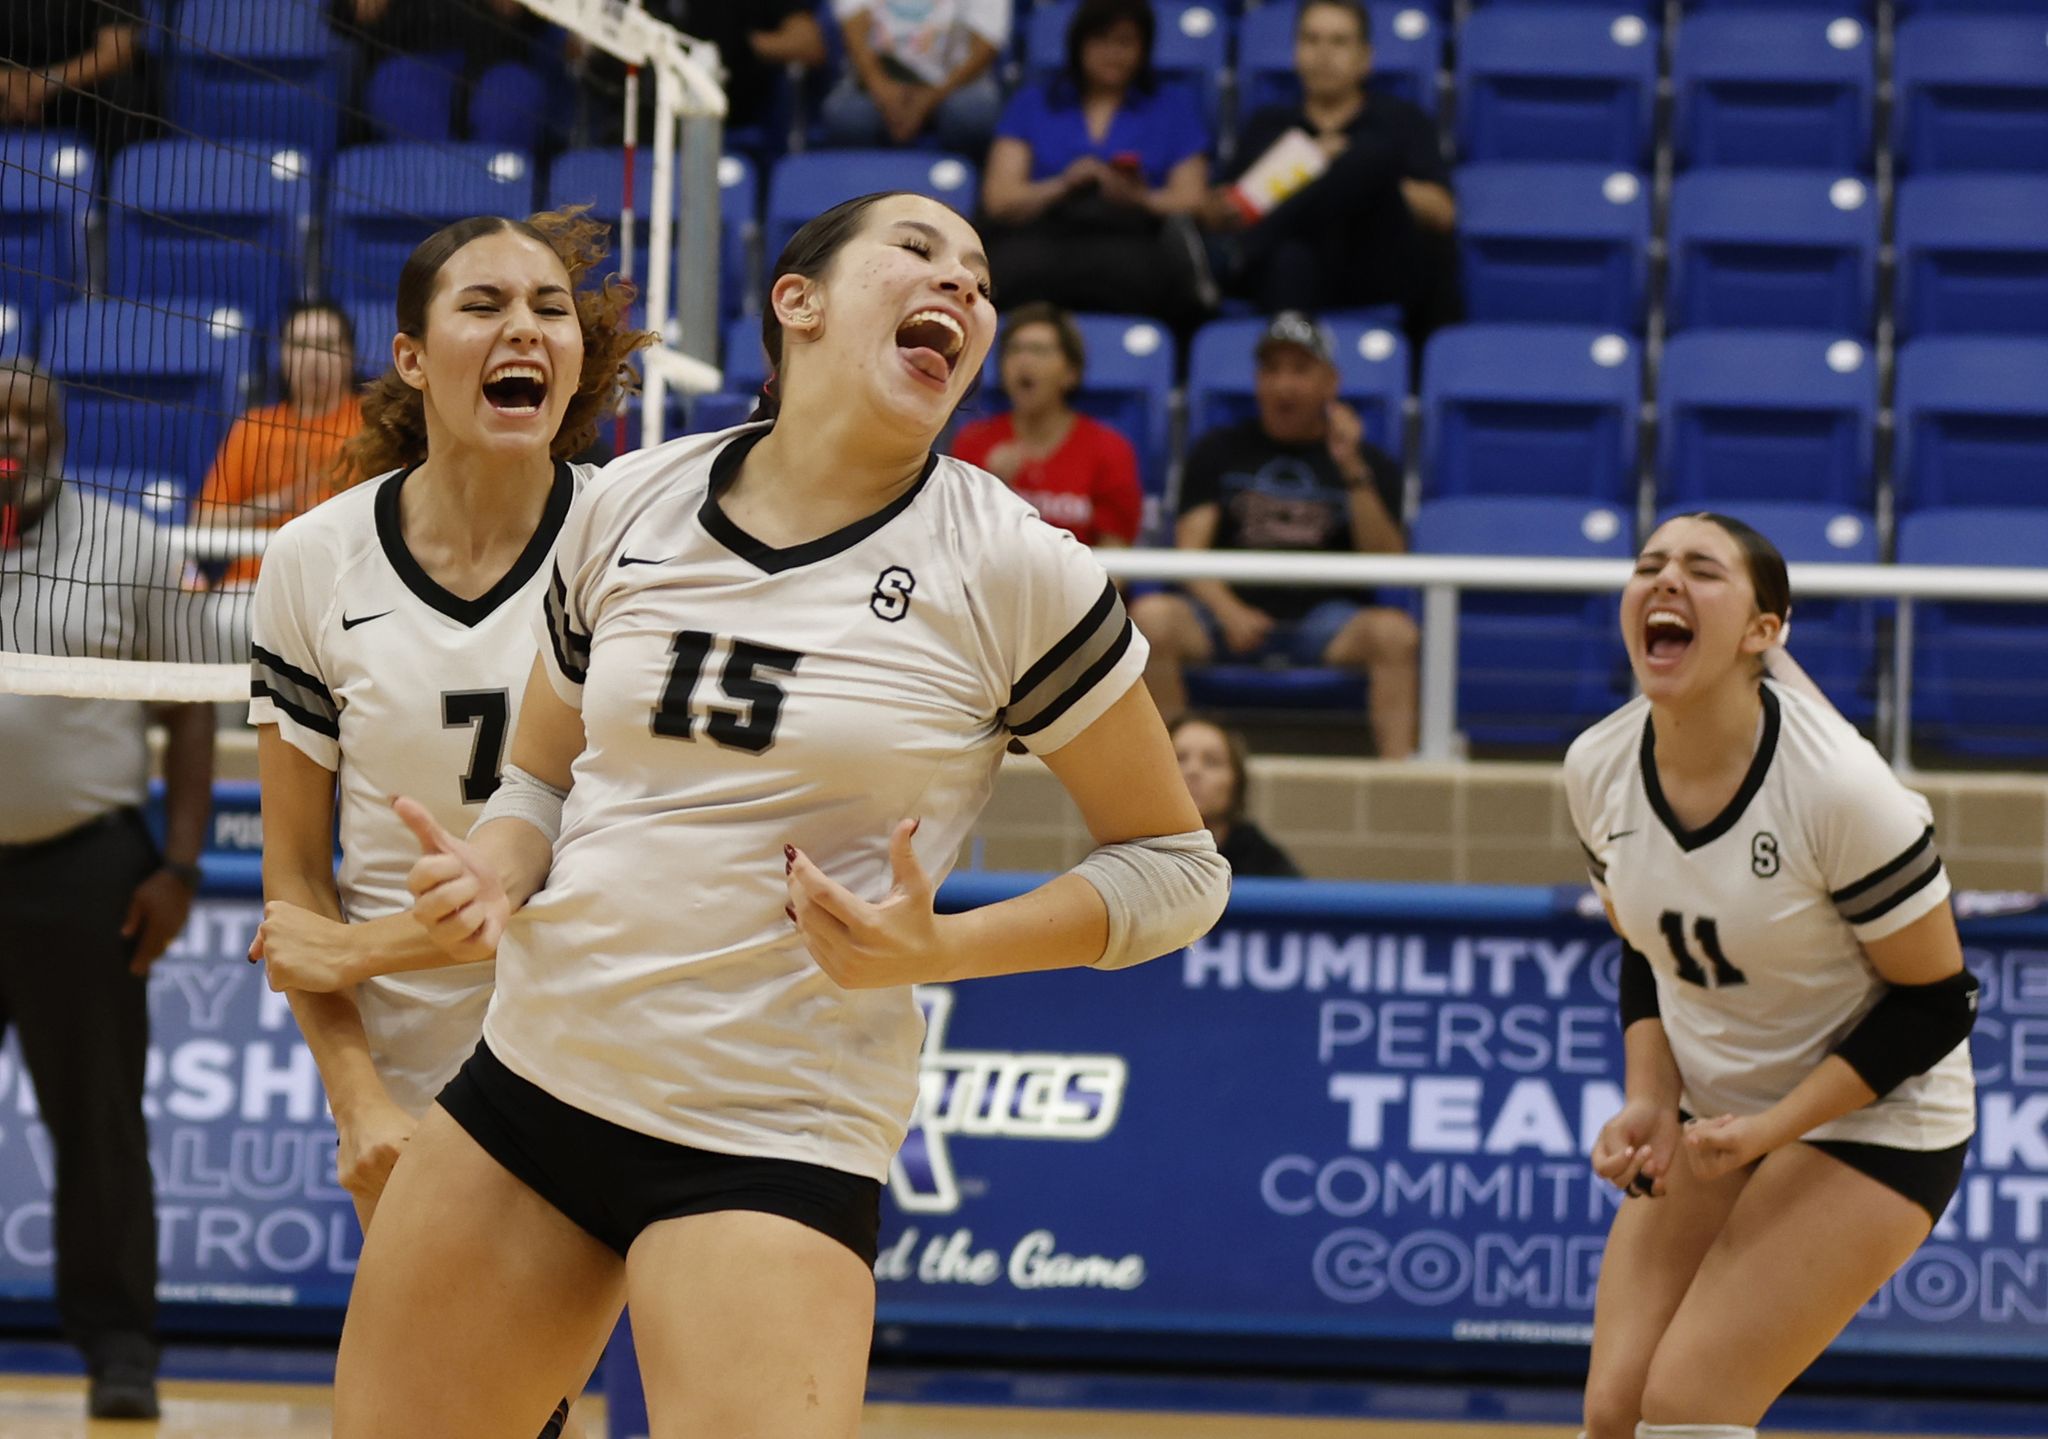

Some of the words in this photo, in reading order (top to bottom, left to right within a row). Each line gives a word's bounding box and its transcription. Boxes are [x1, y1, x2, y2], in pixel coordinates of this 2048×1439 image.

[649, 629, 805, 757] 15
[440, 687, 511, 805] 7
[1751, 830, 1780, 878] S
[1182, 931, 1588, 999] HUMILITY
[1658, 909, 1748, 988] 11
[920, 1054, 1126, 1138] TICS
[2, 1201, 359, 1275] CTROL
[917, 1228, 999, 1286] the
[1008, 1229, 1144, 1291] Game
